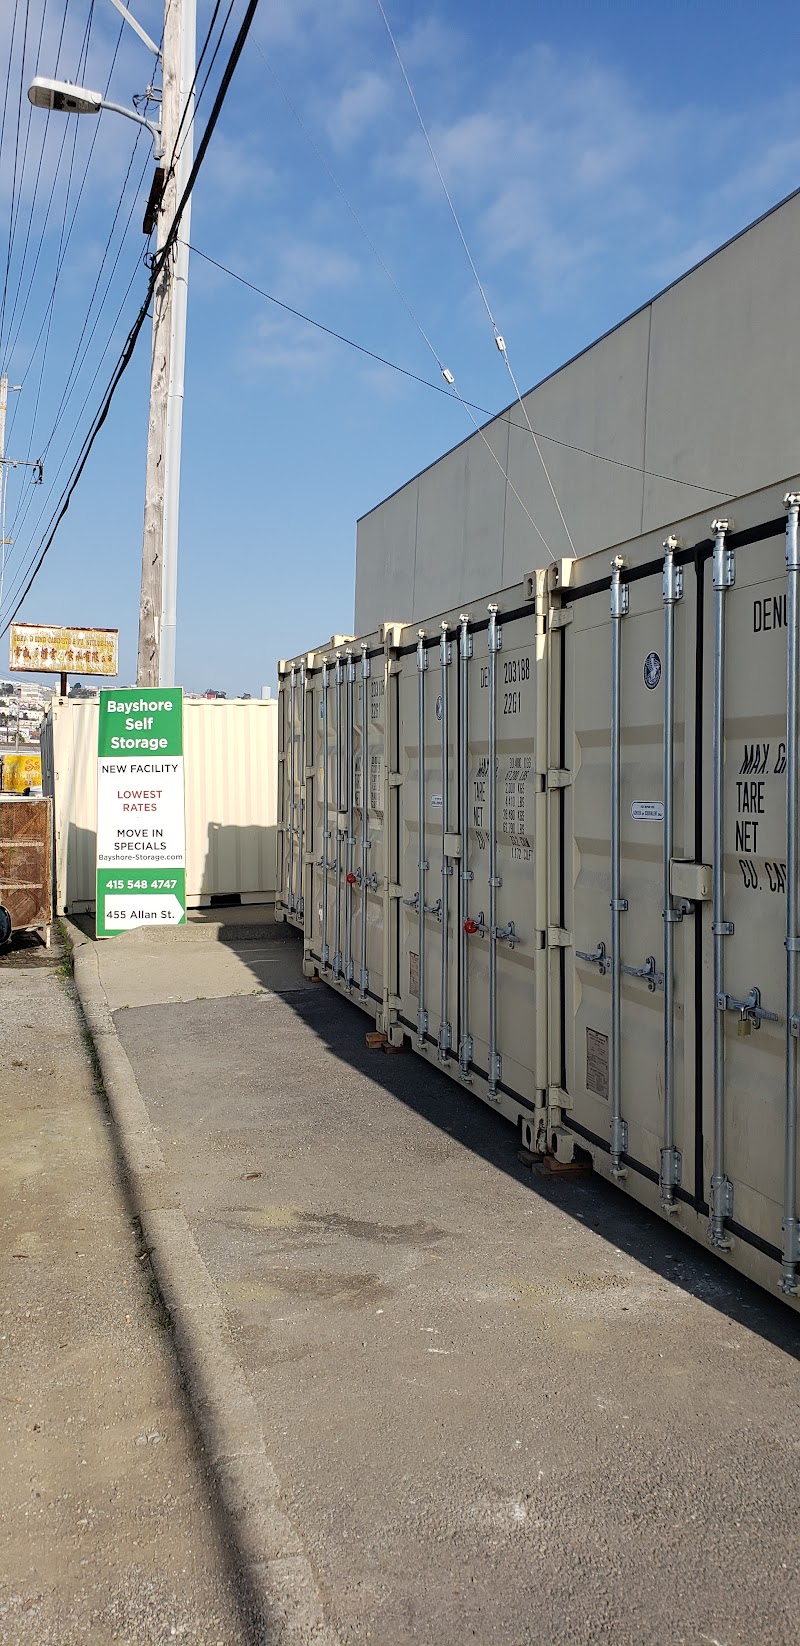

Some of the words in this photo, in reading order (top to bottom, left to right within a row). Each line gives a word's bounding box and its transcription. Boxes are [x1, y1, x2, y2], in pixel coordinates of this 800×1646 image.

[503, 657, 530, 684] 203188
[107, 699, 173, 714] Bayshore
[503, 691, 521, 715] 22G1
[125, 717, 154, 731] Self
[110, 737, 168, 751] Storage
[101, 765, 127, 774] NEW
[130, 764, 178, 773] FACILITY
[117, 790, 163, 799] LOWEST
[473, 781, 486, 802] TARE
[735, 781, 765, 814] TARE
[122, 803, 158, 812] RATES
[473, 806, 484, 828] NET
[117, 829, 149, 838] MOVE
[152, 829, 164, 838] IN
[735, 820, 759, 853] NET
[114, 842, 167, 851] SPECIALS
[98, 854, 183, 862] Bayshore-Storage.com
[738, 859, 762, 891] CU.
[105, 880, 124, 889] 415
[127, 880, 148, 889] 548
[150, 879, 177, 889] 4747
[106, 910, 126, 919] 455
[130, 909, 157, 919] Allan
[160, 910, 175, 919] St.
